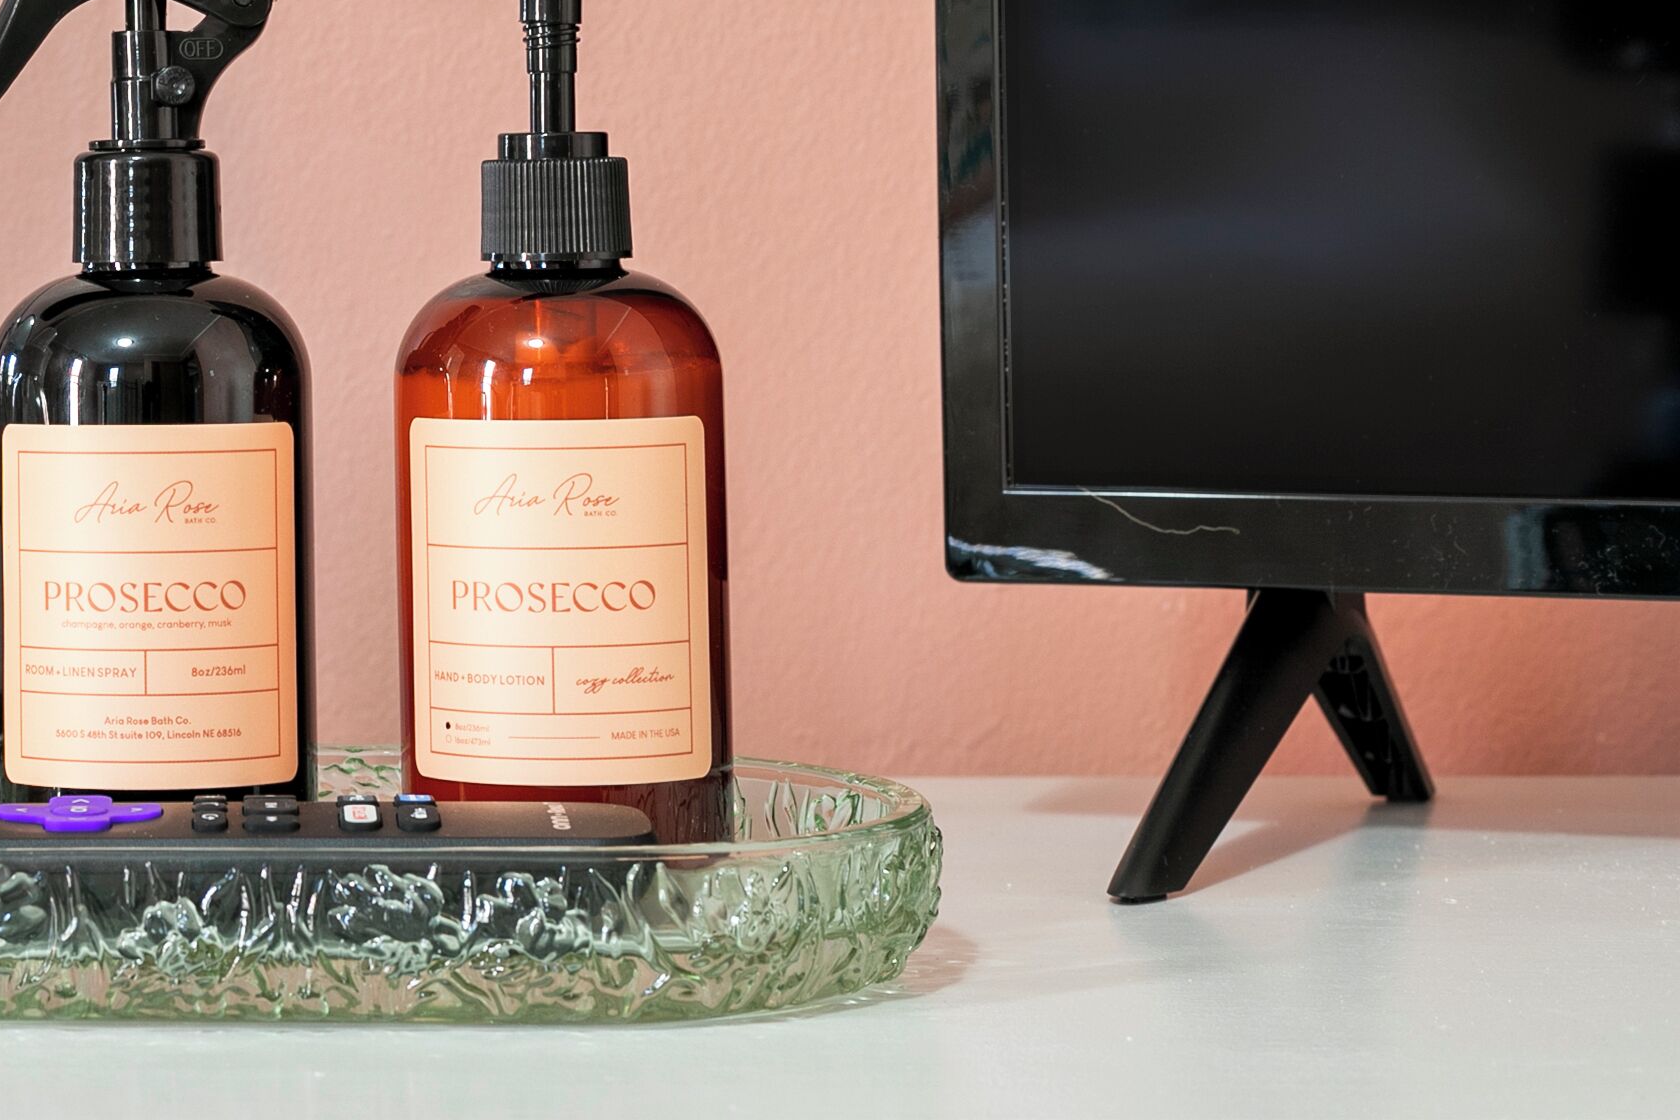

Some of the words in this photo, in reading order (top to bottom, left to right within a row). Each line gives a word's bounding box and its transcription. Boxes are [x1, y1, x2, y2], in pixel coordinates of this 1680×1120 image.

[184, 40, 216, 57] OFF
[75, 480, 147, 523] Aria
[154, 480, 219, 523] Rose
[474, 473, 546, 515] Aria
[553, 472, 620, 515] Rose
[44, 580, 246, 613] PROSECCO
[451, 579, 656, 613] PROSECCO
[61, 619, 117, 631] champagne,
[119, 621, 155, 631] orange,
[157, 619, 206, 630] cranberry,
[208, 618, 232, 628] musk
[25, 663, 54, 676] ROOM
[63, 665, 96, 678] LINEN
[97, 667, 137, 678] SPRAY
[191, 664, 246, 678] 8oz/236ml
[434, 670, 459, 682] HAND
[467, 673, 499, 685] BODY
[500, 675, 545, 686] LOTION
[576, 676, 610, 694] cozy
[612, 666, 674, 686] collection
[104, 716, 124, 726] Aria
[126, 717, 149, 726] Rose
[151, 716, 173, 726] Bath
[175, 716, 192, 726] Co.
[80, 730, 85, 739] S
[108, 730, 119, 740] St
[120, 731, 144, 740] suite
[145, 731, 165, 741] 109,
[167, 730, 201, 739] Lincoln
[202, 729, 215, 738] NE
[216, 728, 242, 738] 68516
[611, 729, 637, 740] MADE
[639, 729, 648, 739] IN
[649, 729, 664, 739] THE
[665, 728, 680, 738] USA
